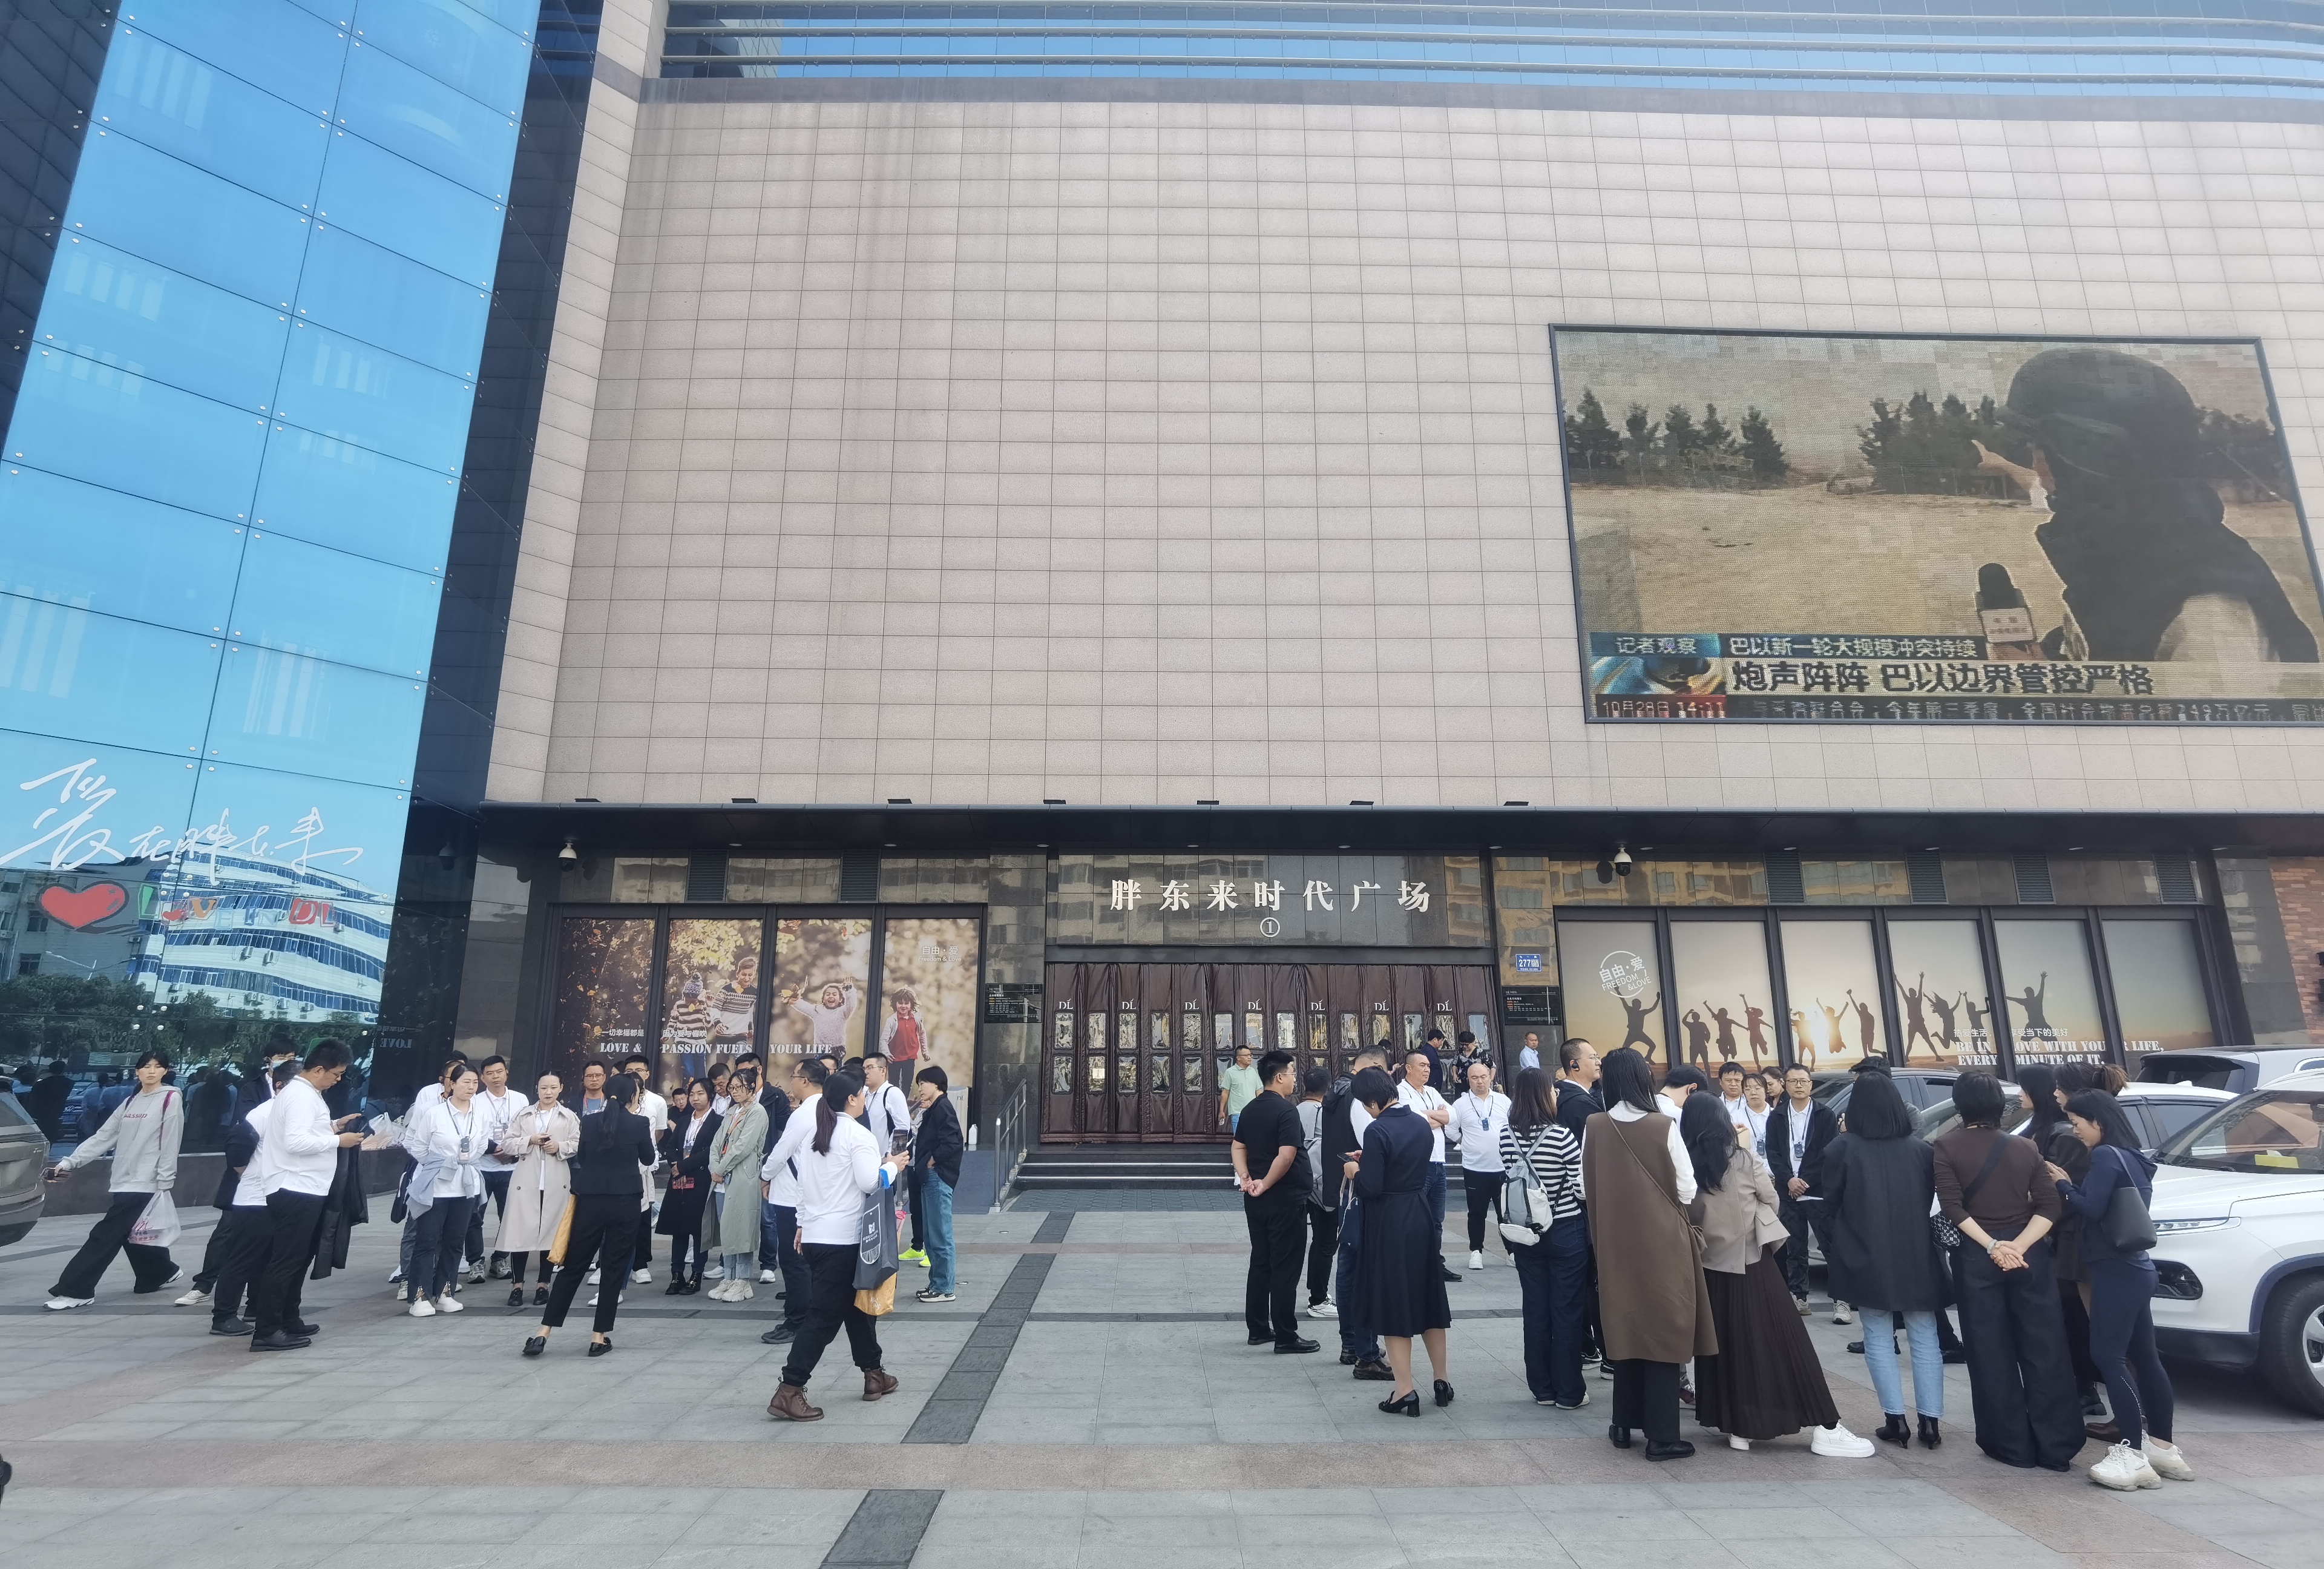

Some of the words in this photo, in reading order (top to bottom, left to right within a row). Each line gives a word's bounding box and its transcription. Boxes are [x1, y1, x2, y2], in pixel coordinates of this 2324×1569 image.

[1615, 637, 1696, 654] 记者观察
[1729, 636, 1978, 657] 巴以新一轮大规模冲突持续
[1732, 660, 1870, 691] 炮声阵阵
[1880, 662, 2153, 695] 巴以边界管控严格
[1110, 880, 1430, 912] 胖东来时代广场
[1519, 959, 1531, 967] 277
[1601, 973, 1639, 991] FREEDOM
[2011, 1028, 2068, 1037] 享受当下的美好
[600, 1042, 629, 1053] LOVE
[633, 1043, 642, 1053] &
[661, 1044, 712, 1054] PASSION
[716, 1044, 752, 1054] FUELS
[769, 1044, 803, 1054] YOUR
[805, 1044, 832, 1054] LIFE
[1955, 1041, 1973, 1052] BE
[1977, 1041, 1991, 1052] IN
[2014, 1041, 2040, 1051] OVE
[2043, 1041, 2078, 1052] WITH
[2131, 1041, 2164, 1052] LIFE,
[1957, 1054, 1997, 1065] EVERY
[2016, 1054, 2064, 1065] MINUTE
[2067, 1054, 2083, 1064] OF
